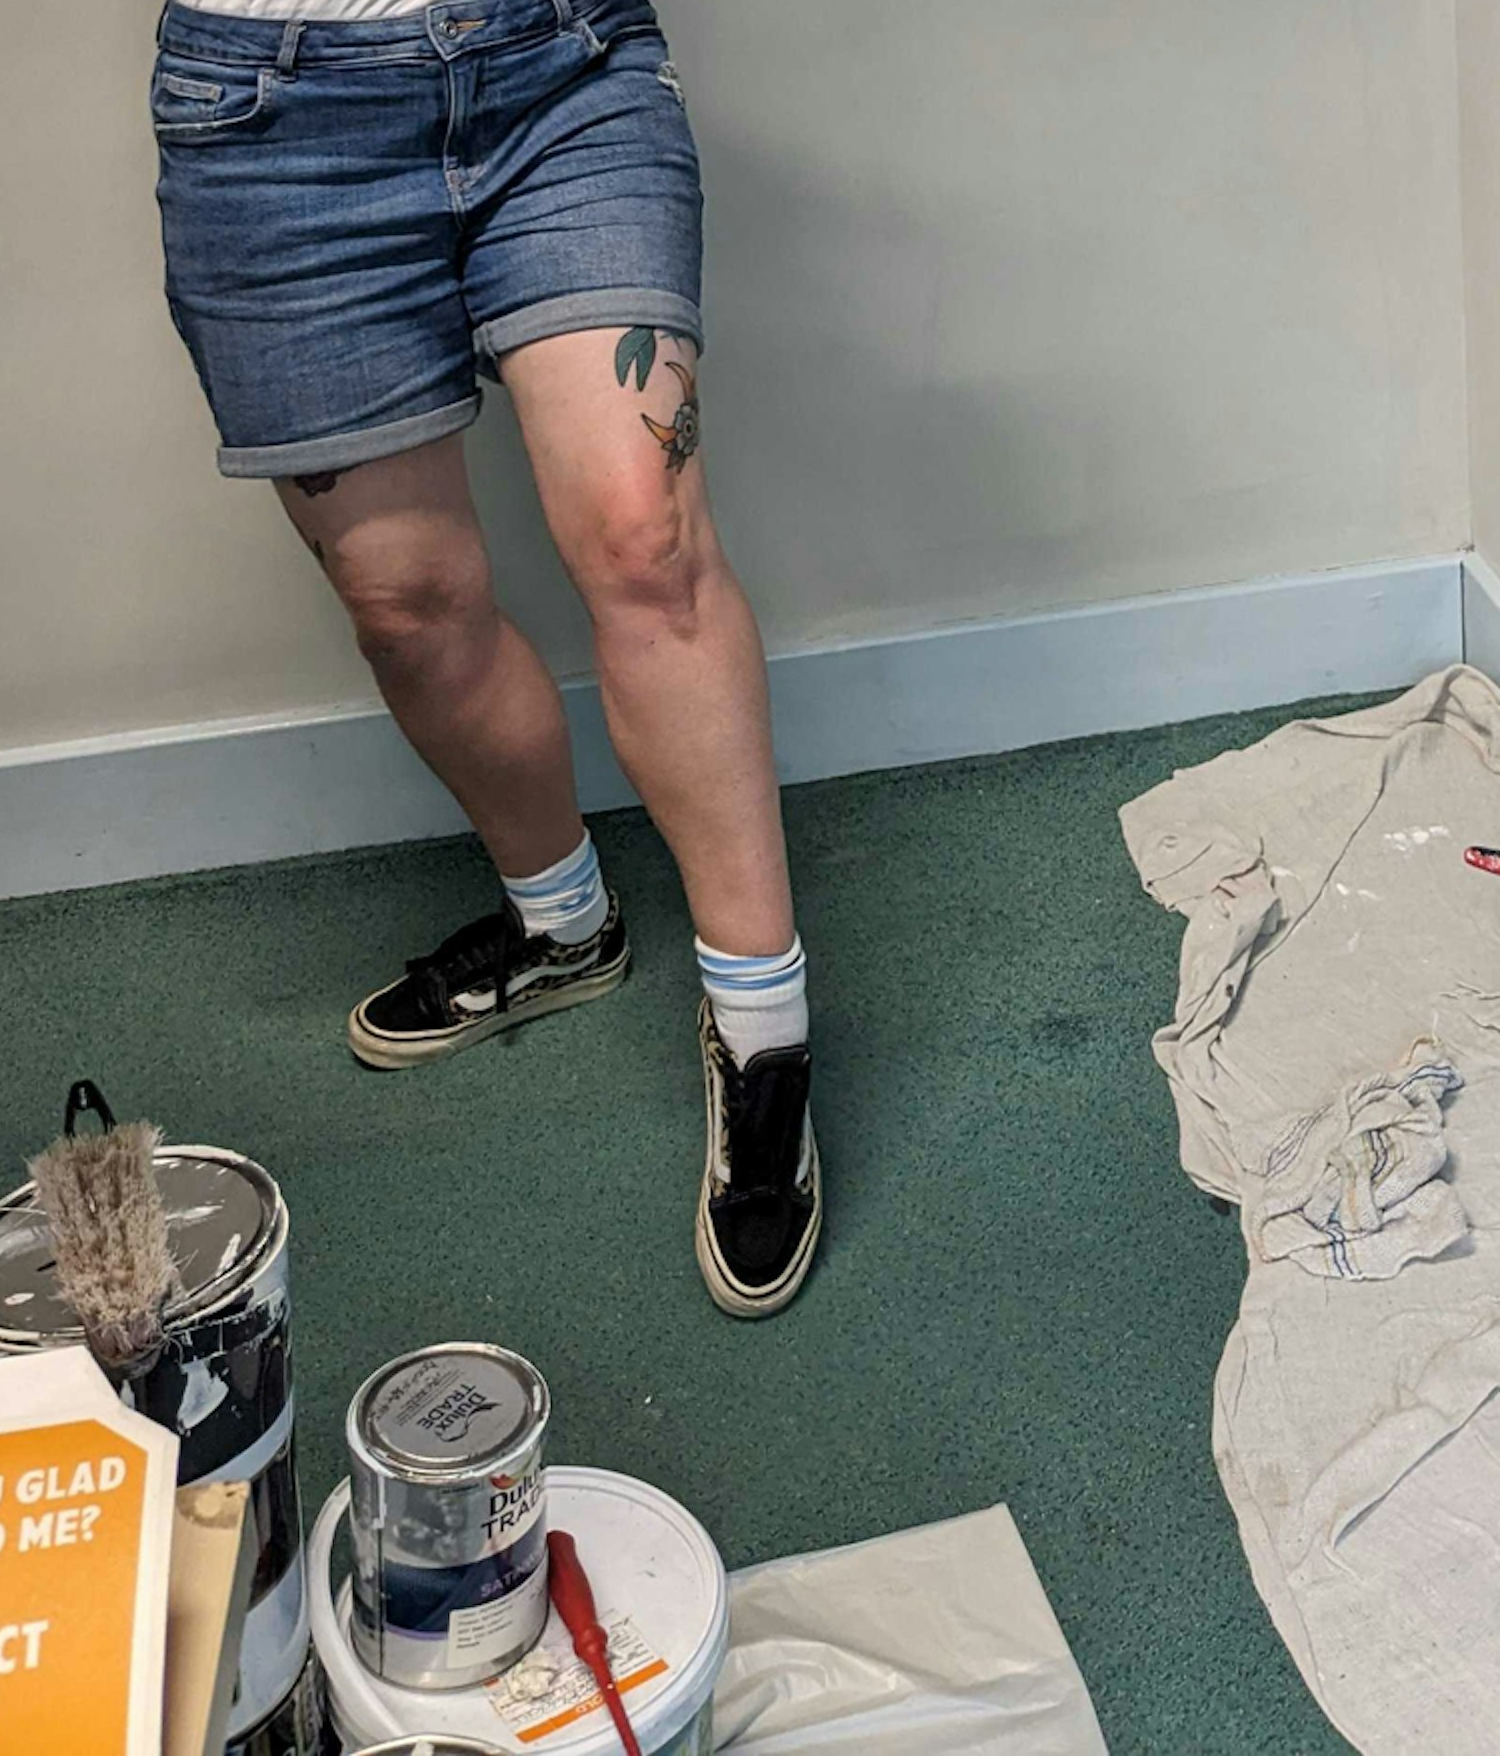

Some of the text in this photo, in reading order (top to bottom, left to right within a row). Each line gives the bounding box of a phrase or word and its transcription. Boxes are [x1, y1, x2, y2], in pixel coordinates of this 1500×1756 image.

[417, 1383, 476, 1431] TRADE
[436, 1392, 487, 1433] Dulux
[15, 1456, 127, 1504] GLAD
[490, 1469, 540, 1516] Dulu
[18, 1505, 101, 1552] ME?
[481, 1484, 541, 1540] TRAD
